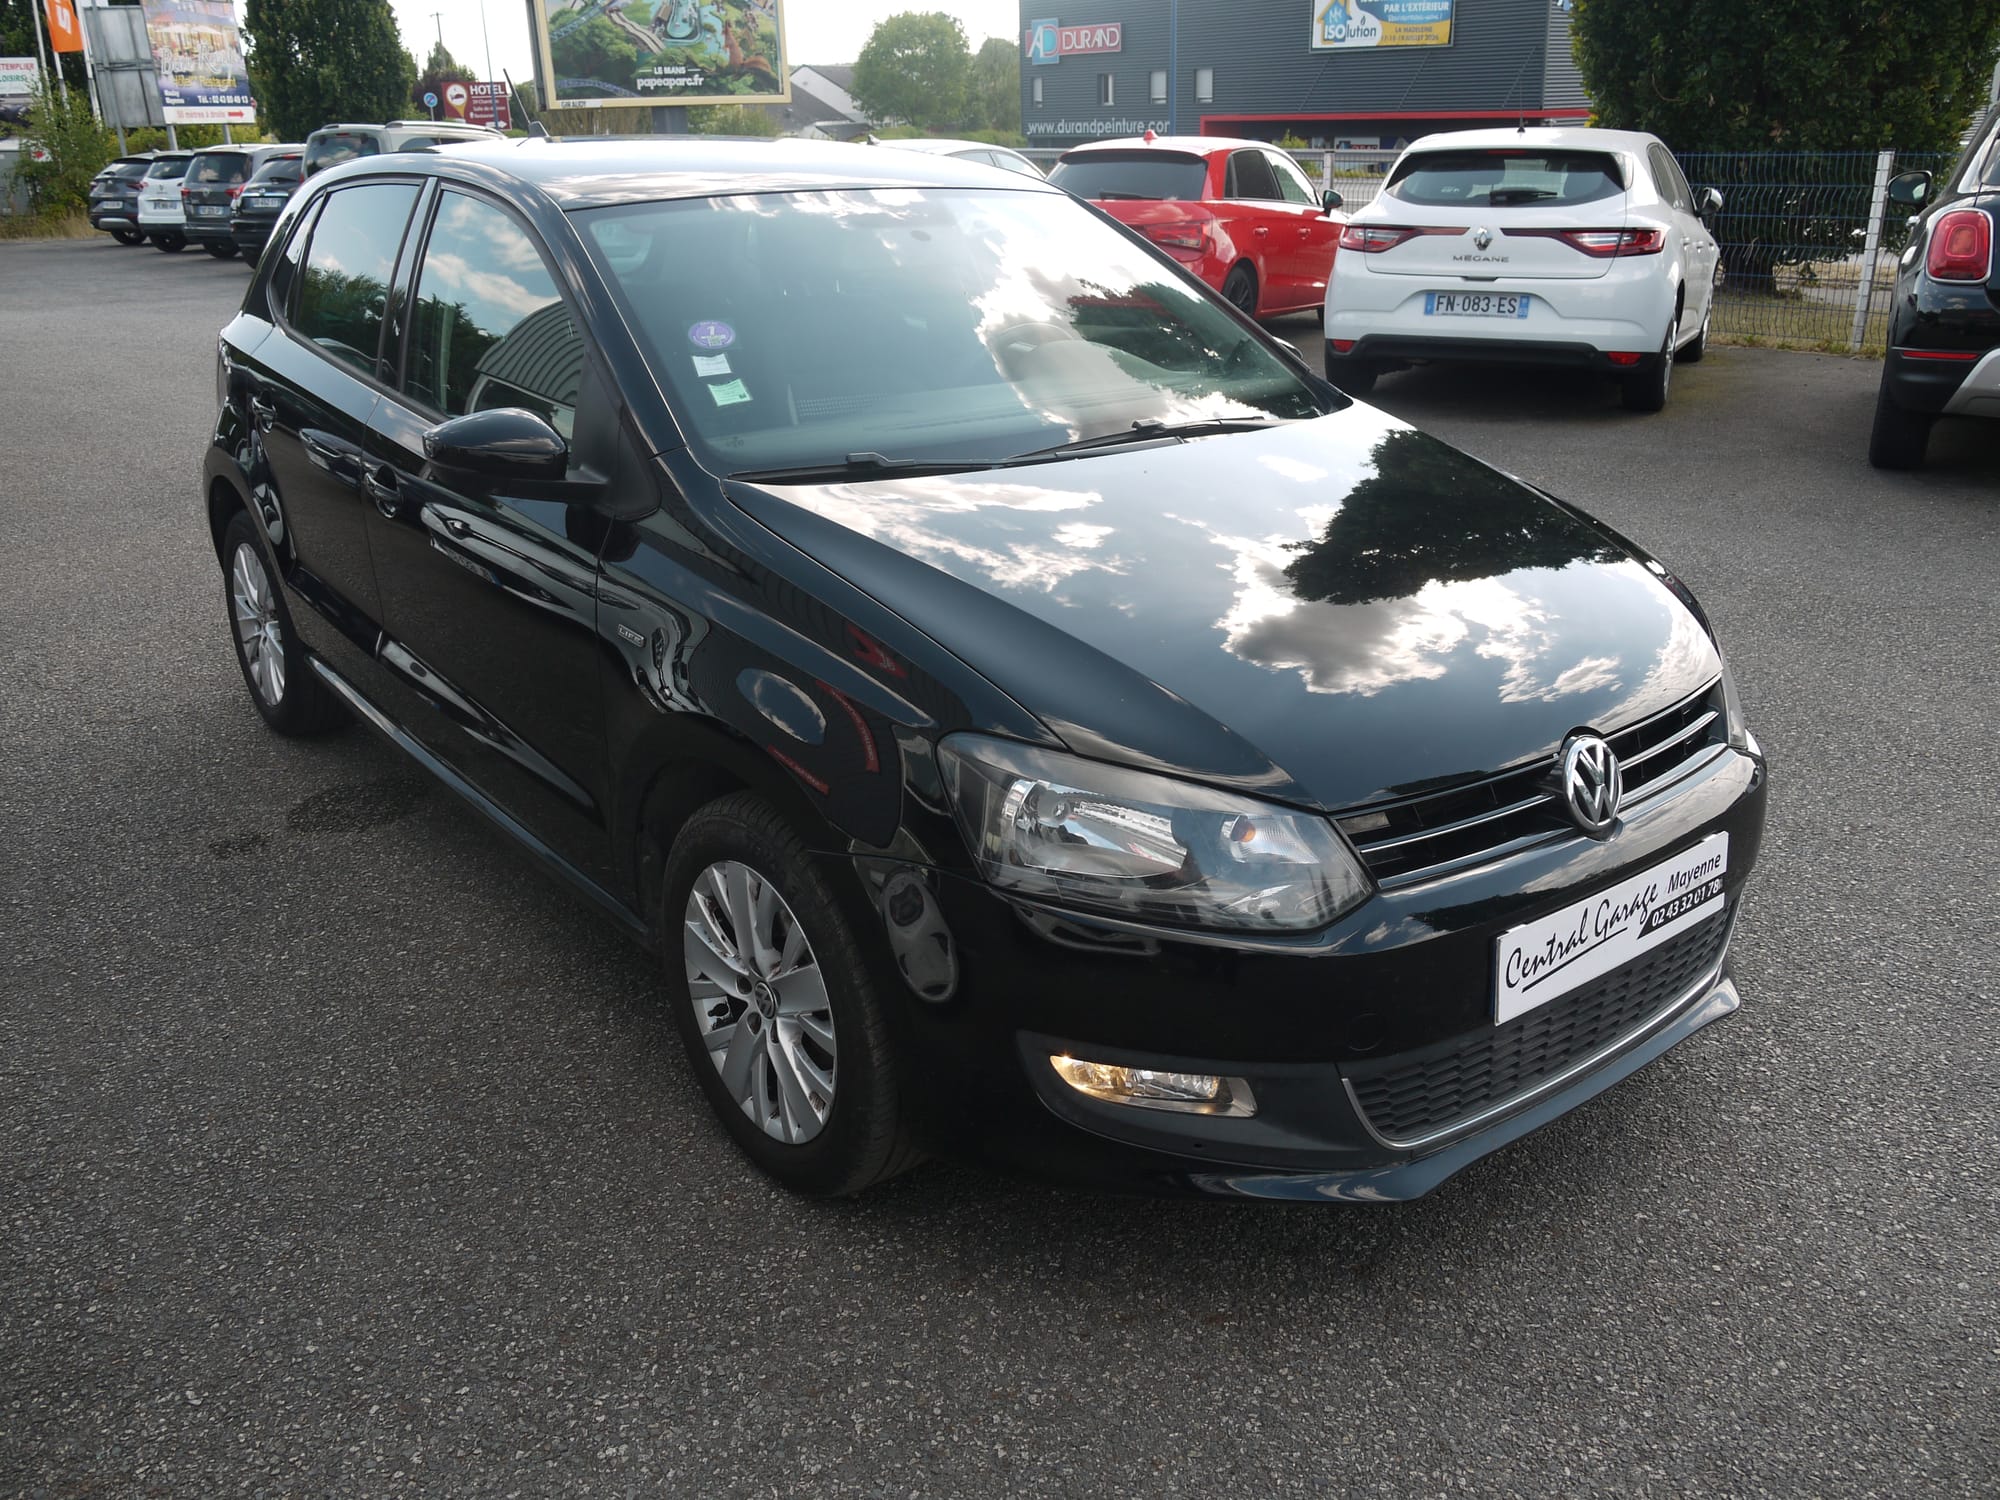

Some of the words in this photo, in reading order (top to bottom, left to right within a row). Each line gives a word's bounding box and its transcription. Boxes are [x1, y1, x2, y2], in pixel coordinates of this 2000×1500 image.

[1062, 27, 1120, 51] DURAND
[654, 67, 663, 75] LE
[664, 66, 687, 74] MANS
[637, 74, 705, 90] papeaparc.fr
[1028, 118, 1170, 136] www.durandpeintureco
[1436, 295, 1518, 314] FN-083-ES
[1667, 854, 1721, 894] Mayenne
[1651, 908, 1666, 928] 02
[1666, 900, 1680, 919] 43
[1680, 892, 1694, 912] 32
[1694, 885, 1706, 905] 01
[1505, 908, 1589, 988] Central
[1594, 882, 1659, 939] Garage
